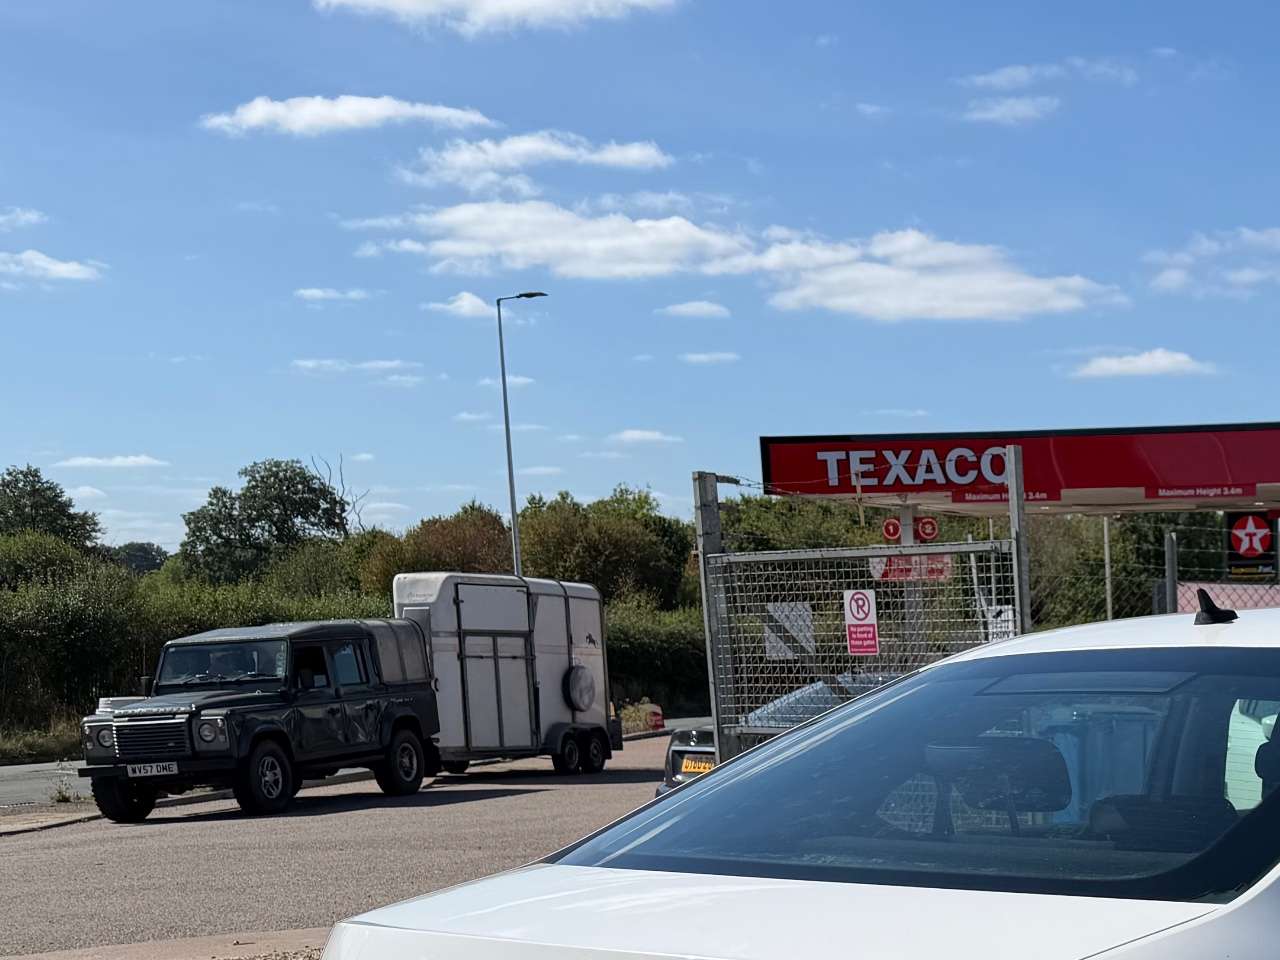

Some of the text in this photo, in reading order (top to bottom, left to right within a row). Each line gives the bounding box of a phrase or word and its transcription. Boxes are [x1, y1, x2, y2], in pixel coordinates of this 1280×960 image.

[816, 446, 1007, 487] TEXACO
[1158, 488, 1195, 497] Maximum
[1196, 487, 1221, 497] Height
